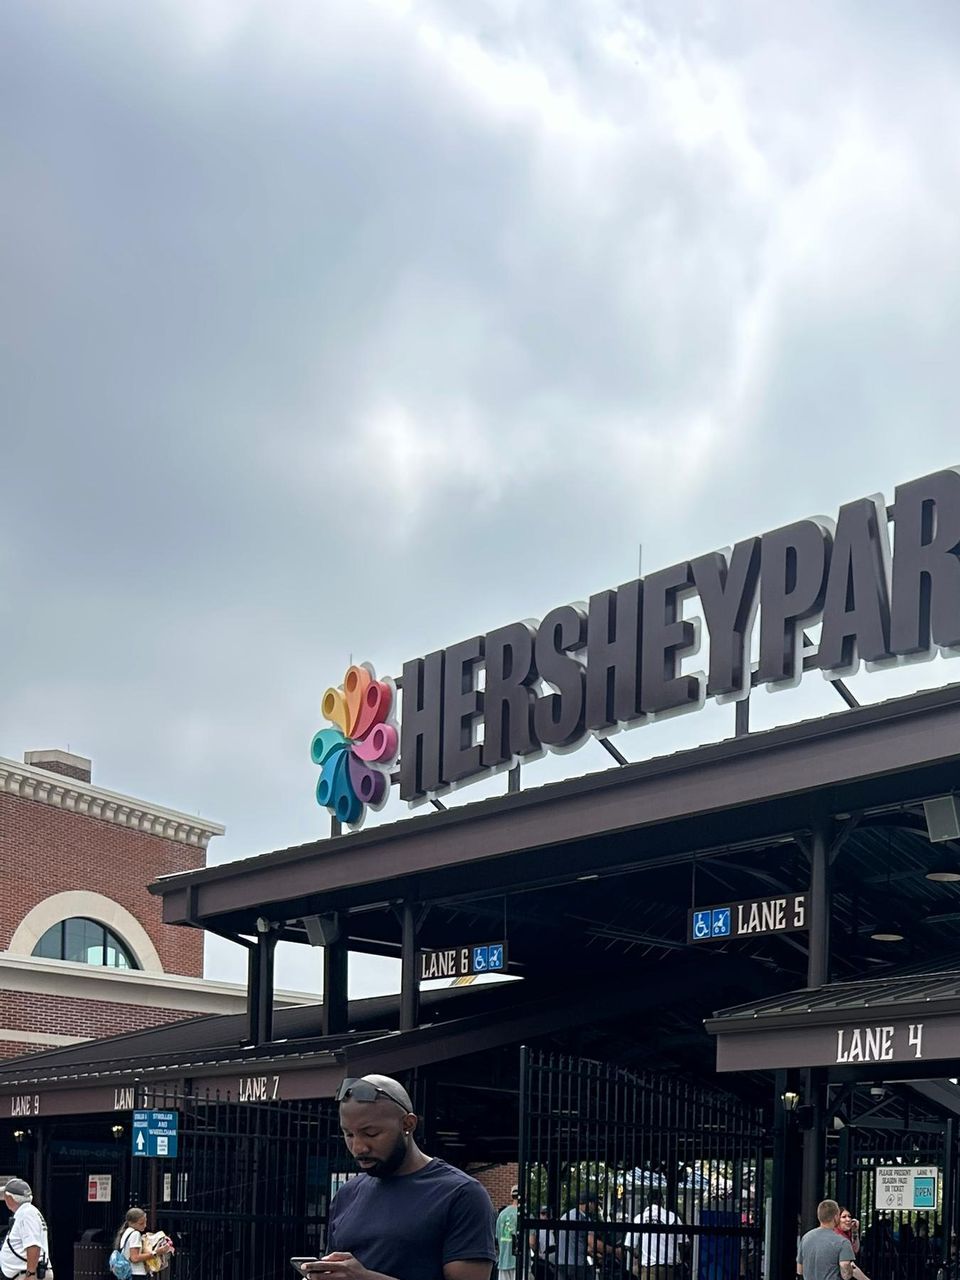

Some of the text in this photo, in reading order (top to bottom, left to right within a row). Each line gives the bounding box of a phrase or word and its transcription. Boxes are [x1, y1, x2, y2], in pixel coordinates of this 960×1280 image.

[737, 896, 805, 934] LANE 5
[421, 948, 469, 978] LANE 6
[836, 1024, 924, 1063] LANE 4
[240, 1075, 280, 1101] LANE 7
[11, 1094, 40, 1116] LANE 9
